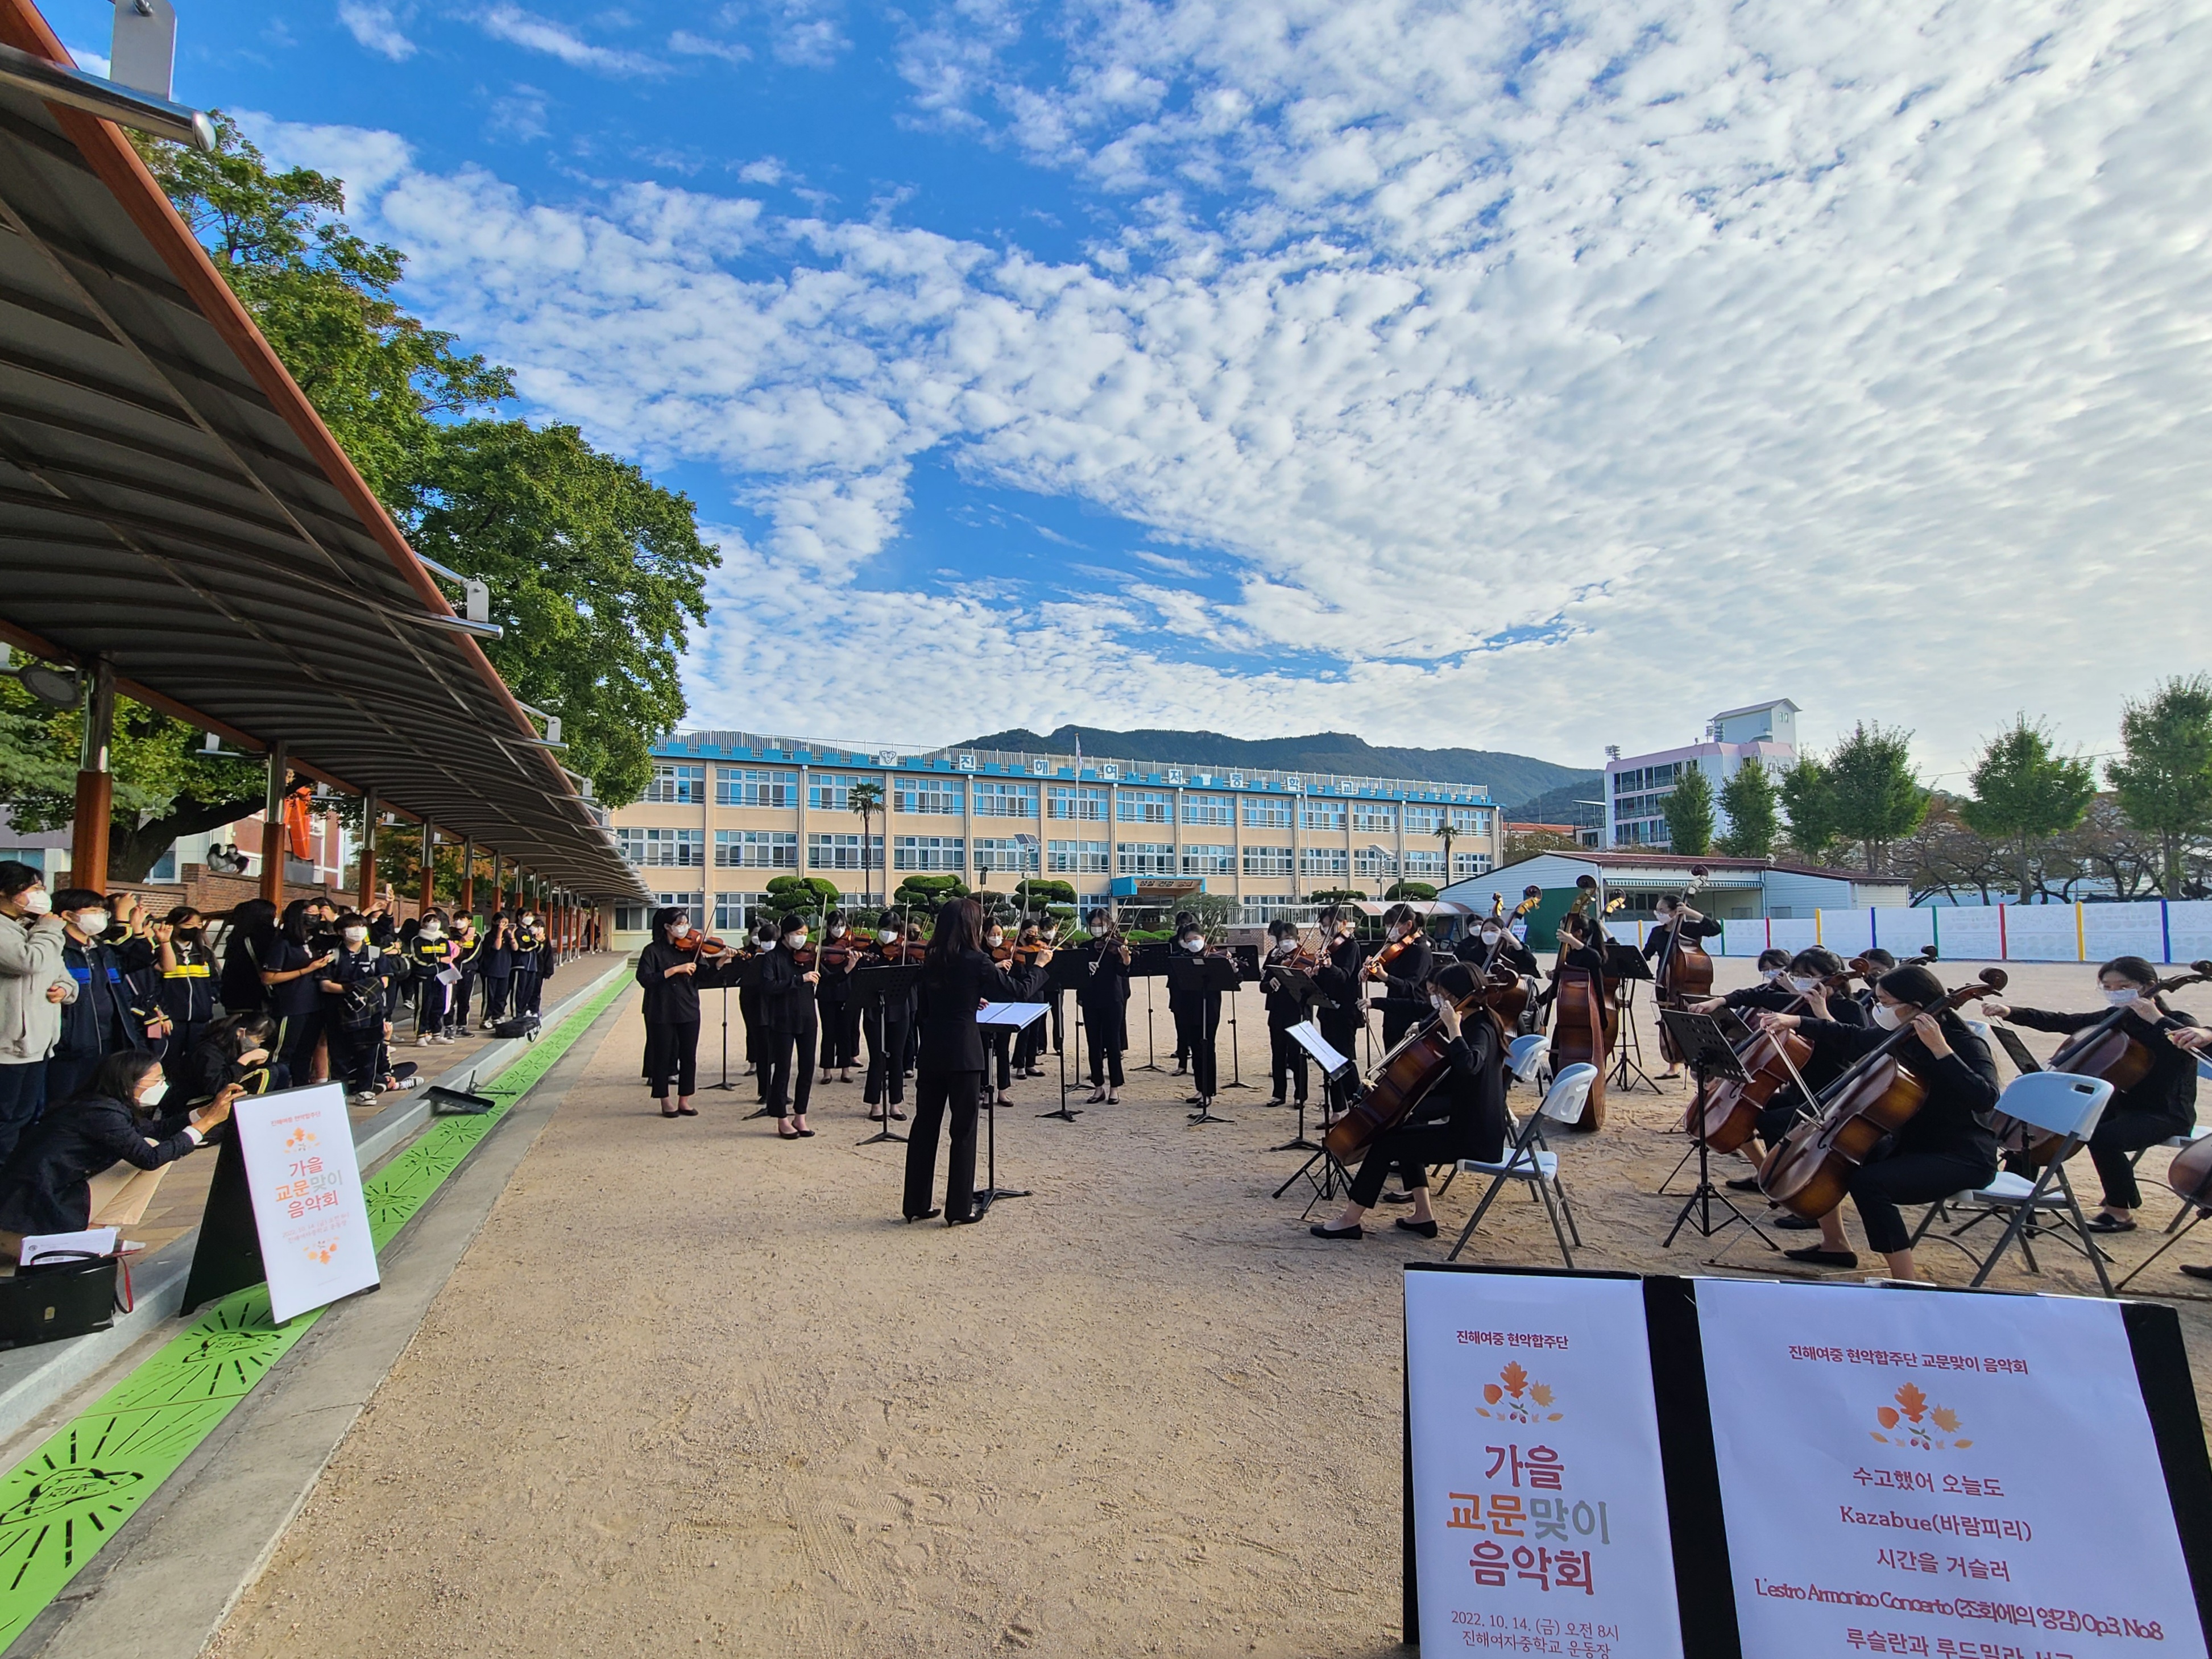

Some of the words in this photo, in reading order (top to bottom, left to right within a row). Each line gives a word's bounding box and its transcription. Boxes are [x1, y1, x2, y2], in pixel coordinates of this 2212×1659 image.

[289, 1156, 324, 1177] 가을
[275, 1169, 343, 1202] 교문맞이
[287, 1190, 339, 1219] 음악회
[1456, 1330, 1505, 1346] 진해여중
[1507, 1333, 1569, 1350] 현악합주단
[1788, 1345, 1844, 1363] 진해여중
[1846, 1348, 1917, 1367] 현악합주단
[1921, 1354, 1980, 1372] 교문맞이
[1983, 1358, 2029, 1375] 음악회
[1485, 1444, 1564, 1491] 가을
[1853, 1467, 1935, 1493] 수고했어
[1942, 1474, 2004, 1497] 오늘도
[1446, 1492, 1610, 1545] 교문맞이
[1840, 1505, 2032, 1542] Kazabue(바람피리)
[1469, 1540, 1594, 1596] 음악회
[1877, 1549, 1938, 1574] 시간을
[1946, 1556, 2011, 1582] 거슬러
[1754, 1578, 1807, 1600] L'estro
[1807, 1583, 1879, 1607] Armonico
[1880, 1591, 1954, 1616] Concerto
[1954, 1598, 2036, 1628] (조화에의
[2036, 1607, 2082, 1633] 영감)
[1451, 1610, 1485, 1627] 2022.
[1490, 1614, 1508, 1629] 10.
[1513, 1617, 1531, 1632] 14.
[1535, 1618, 1560, 1636] (금)
[1564, 1622, 1593, 1639] 오전
[1597, 1624, 1619, 1642] 8시
[1846, 1627, 1929, 1657] 루슬란과
[1462, 1629, 1563, 1654] 진해여자중학교
[1567, 1640, 1612, 1659] 운동장
